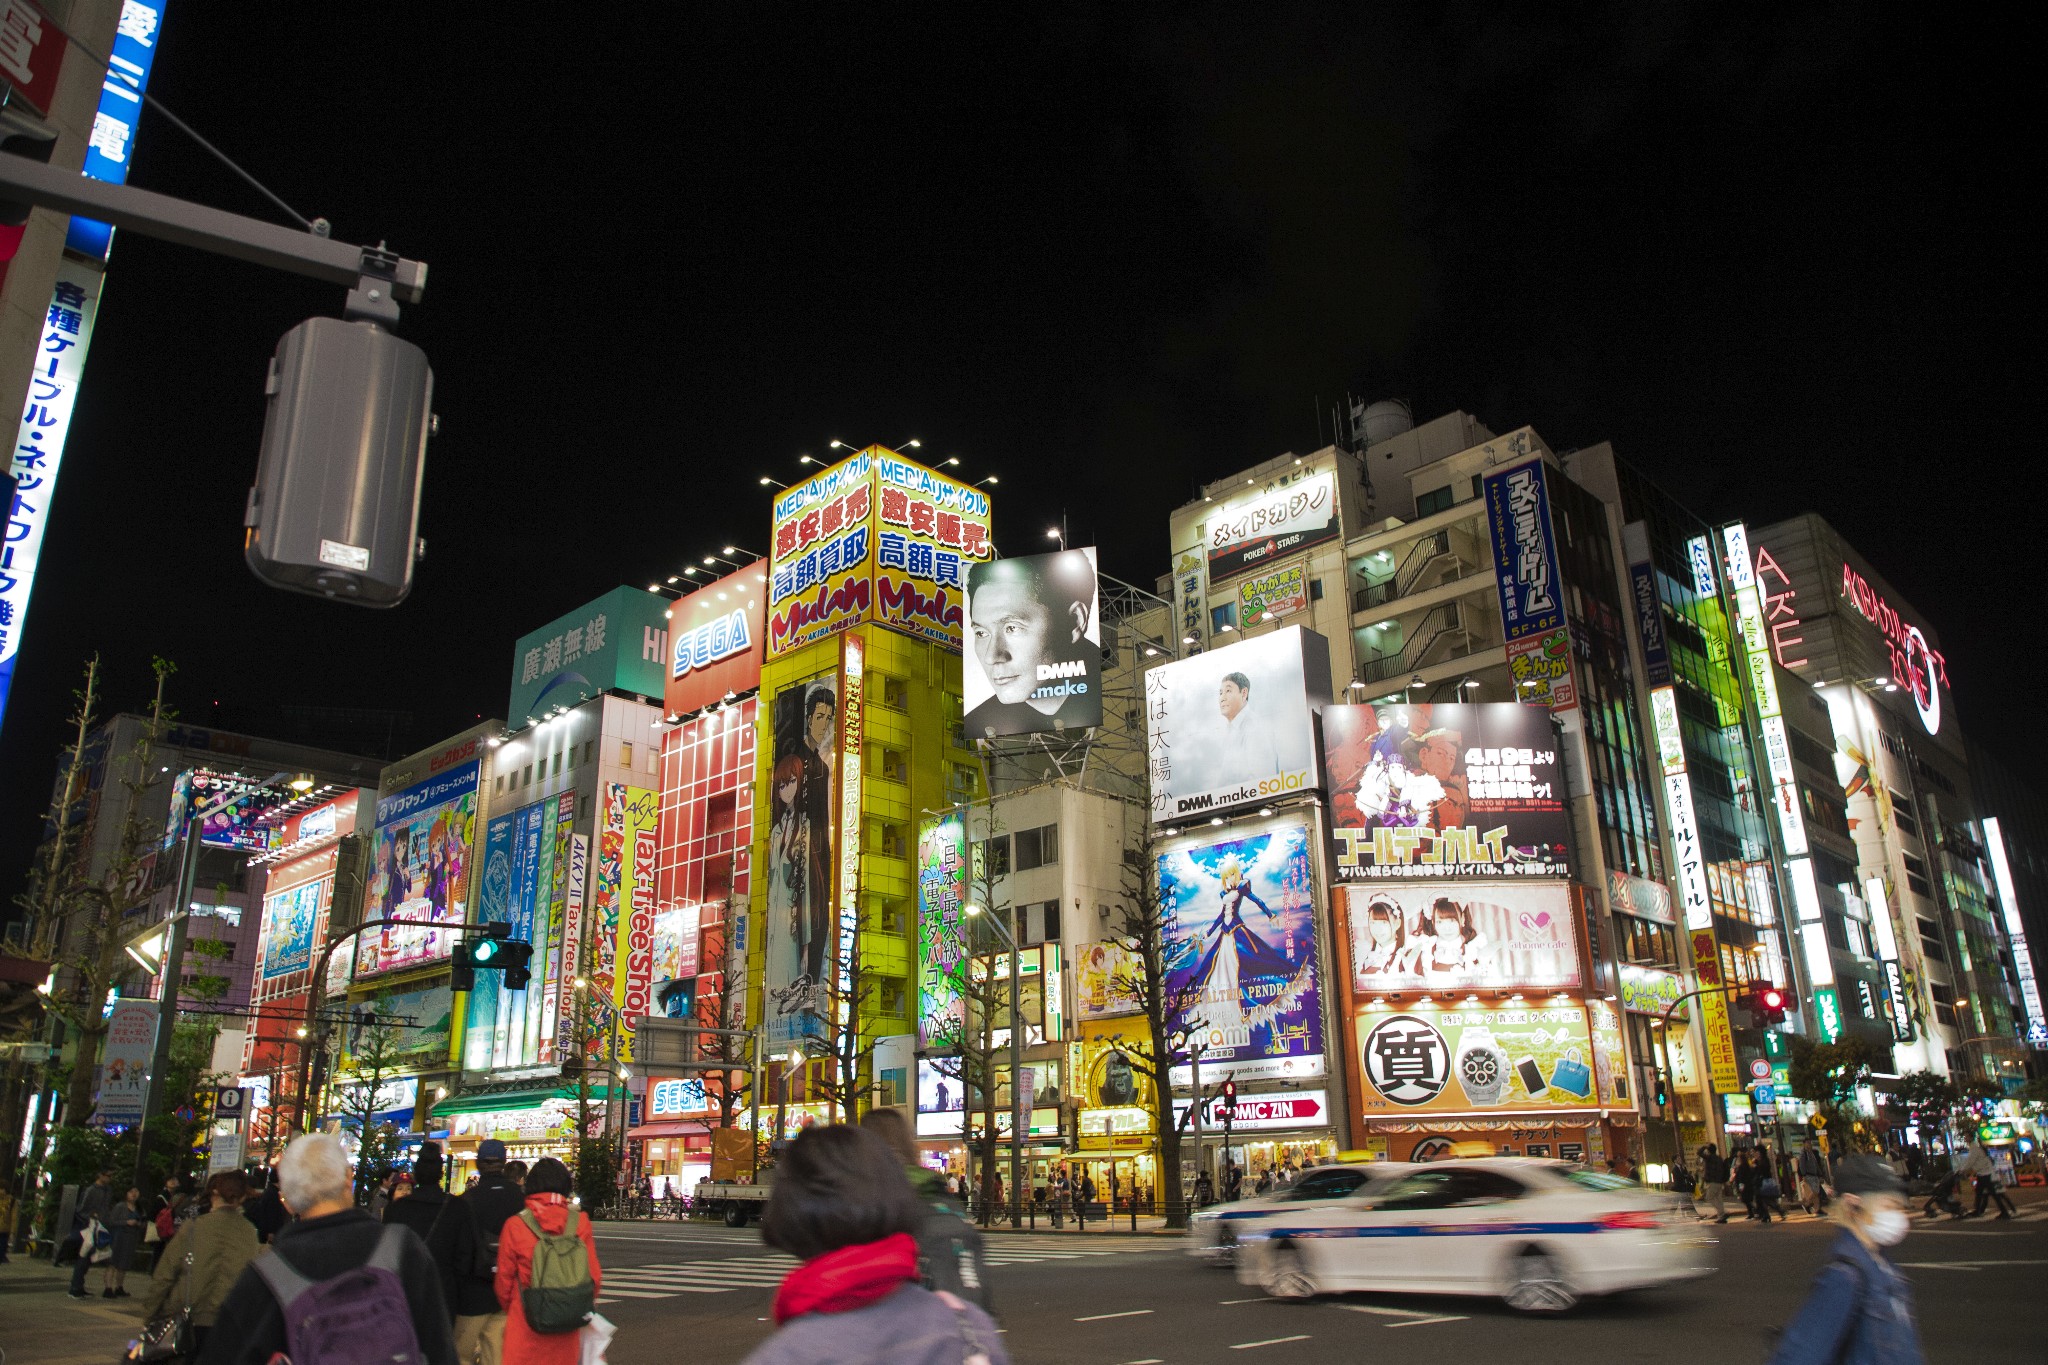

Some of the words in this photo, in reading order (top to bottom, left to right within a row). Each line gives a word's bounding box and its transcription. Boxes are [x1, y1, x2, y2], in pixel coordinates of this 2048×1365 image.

[775, 483, 871, 553] 激安販売
[881, 477, 988, 544] 激安販売
[1214, 486, 1328, 546] メイドカジノ
[772, 524, 869, 605] 高額買取
[878, 533, 963, 590] 高額買
[1243, 546, 1266, 563] POKER
[1277, 533, 1301, 549] STARS
[771, 575, 871, 653] Mulan
[807, 615, 831, 633] AKIBA
[877, 576, 963, 634] Mula
[924, 616, 949, 634] AKIBA
[672, 607, 753, 679] SEGA
[1036, 659, 1087, 681] DMM
[1511, 654, 1569, 680] まんが
[1751, 656, 1772, 713] Submarine
[1147, 668, 1174, 820] 次は太陽か。
[389, 785, 430, 816] ソフマップ
[1258, 770, 1307, 796] solar
[842, 758, 860, 899] お売り下さい
[1334, 825, 1509, 867] ゴールデンカムイ
[942, 843, 959, 963] 日本最大級
[925, 878, 941, 987] 電子タバコ
[560, 974, 576, 1017] Shop
[1283, 1001, 1303, 1012] 2018
[1719, 1024, 1734, 1065] FREE
[652, 1077, 707, 1115] SEGA
[1271, 1101, 1294, 1118] ZIN
[1511, 1127, 1563, 1142] チケット
